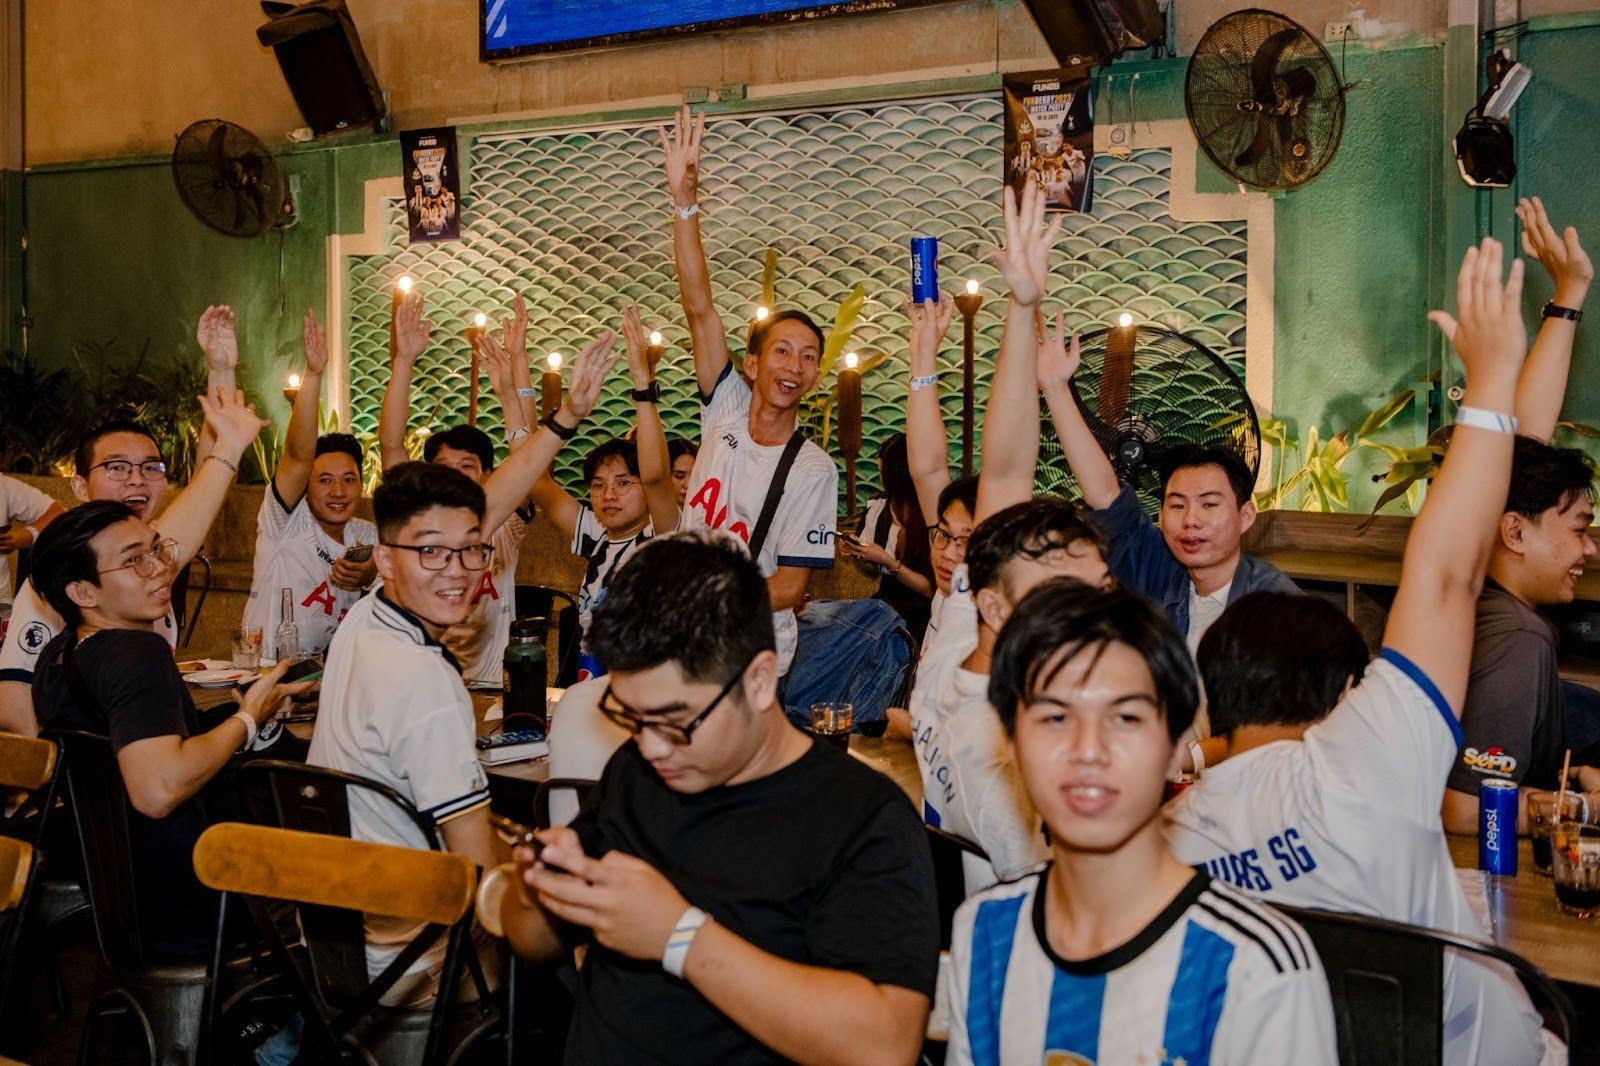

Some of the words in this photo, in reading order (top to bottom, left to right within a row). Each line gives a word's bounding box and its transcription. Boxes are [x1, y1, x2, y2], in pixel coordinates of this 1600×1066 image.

[913, 253, 923, 286] pepsi
[1485, 808, 1501, 851] pepsi
[1202, 848, 1272, 892] URS
[1268, 828, 1316, 881] SG
